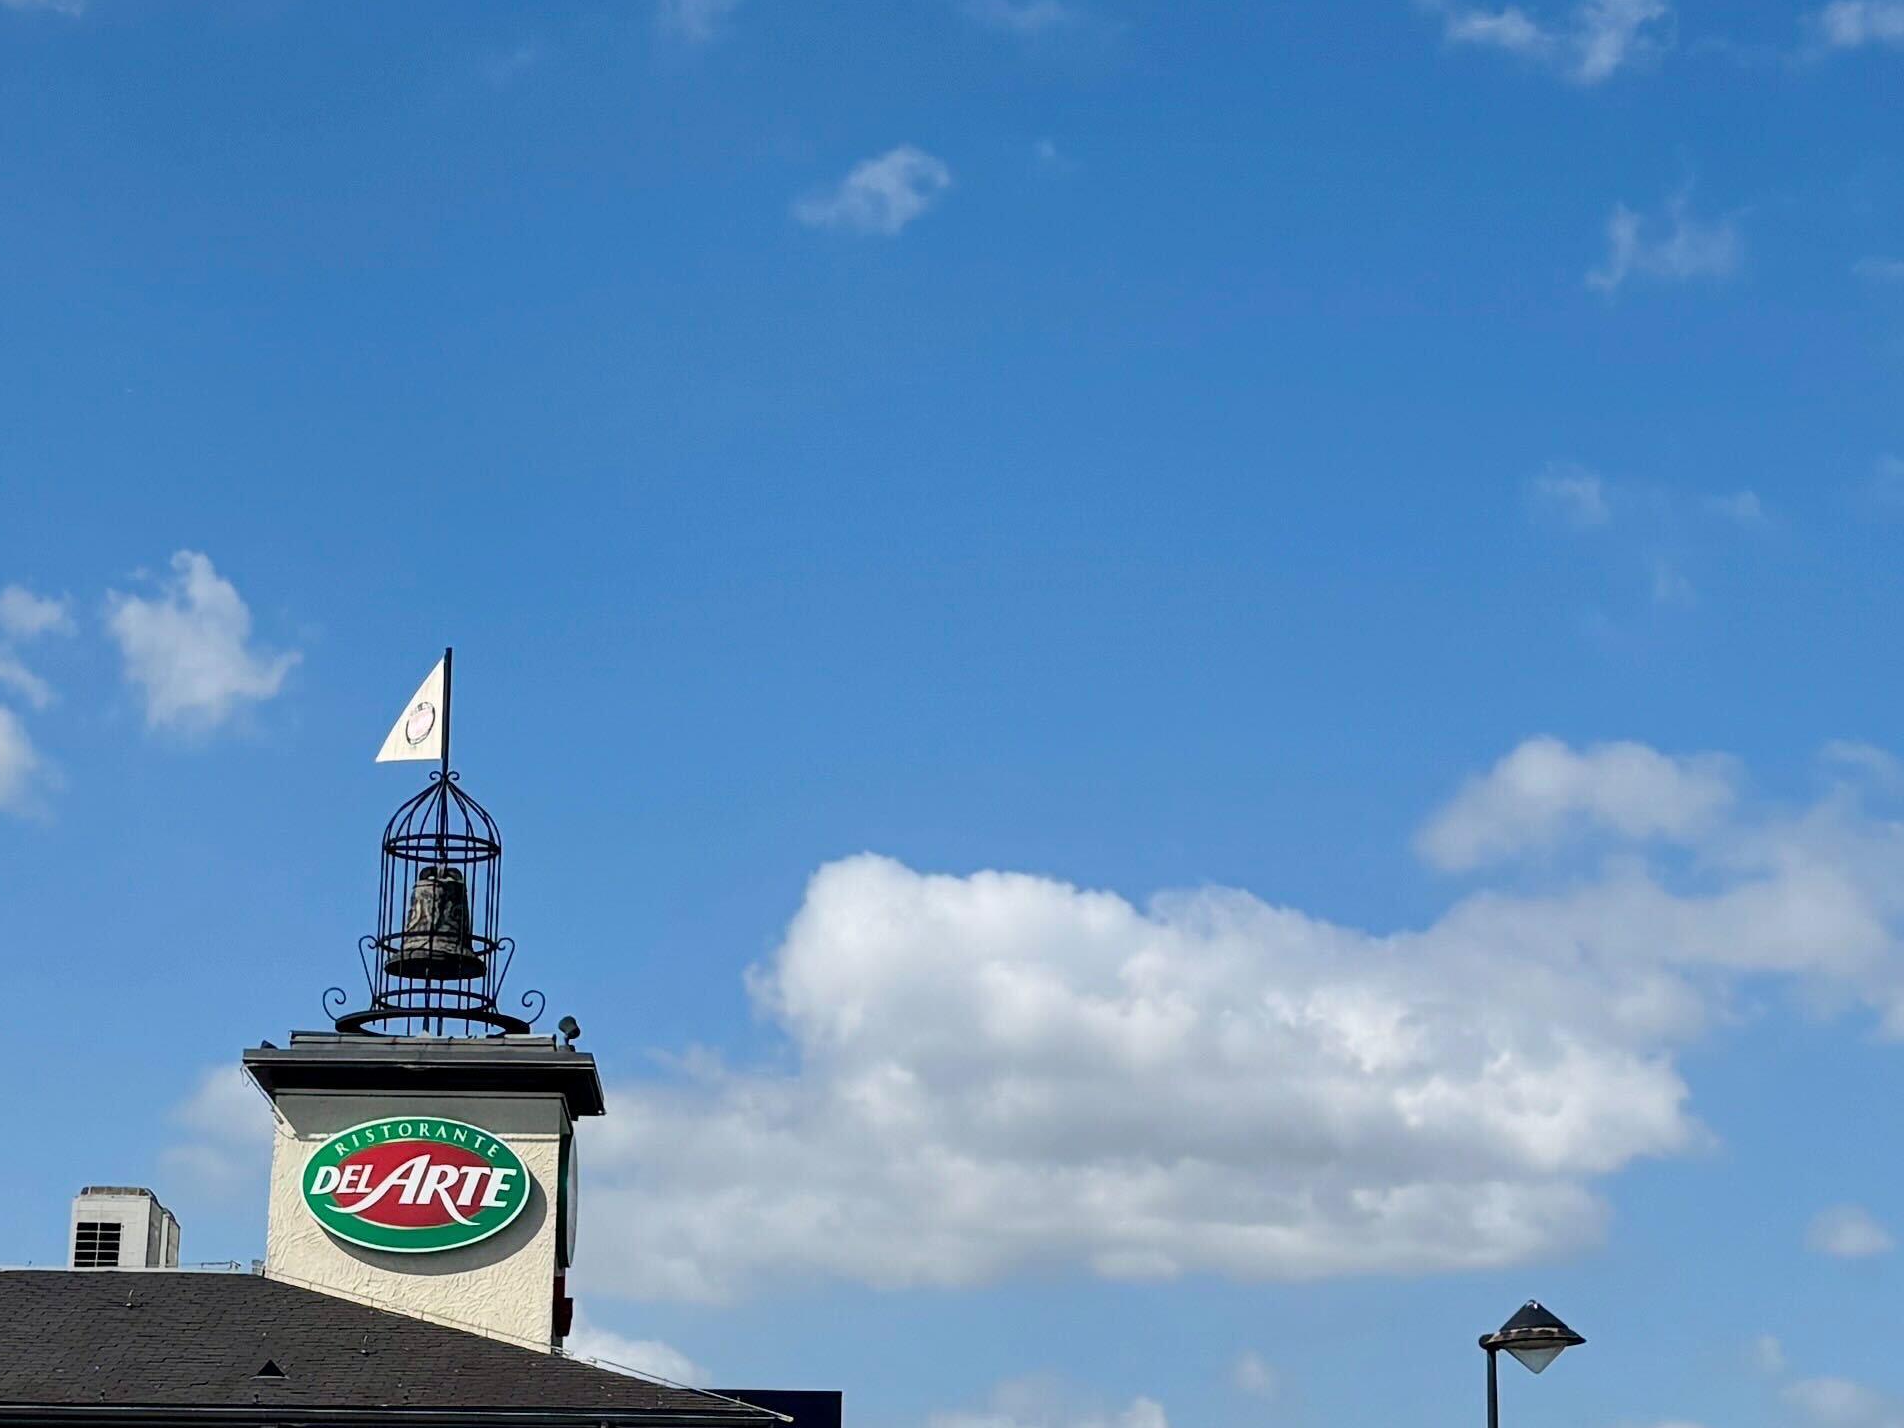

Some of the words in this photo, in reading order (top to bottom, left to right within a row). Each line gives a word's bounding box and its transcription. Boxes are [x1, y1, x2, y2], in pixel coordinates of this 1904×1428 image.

[334, 1122, 500, 1158] RISTORANTE
[309, 1164, 375, 1195] DEL
[324, 1153, 518, 1226] ARTE
